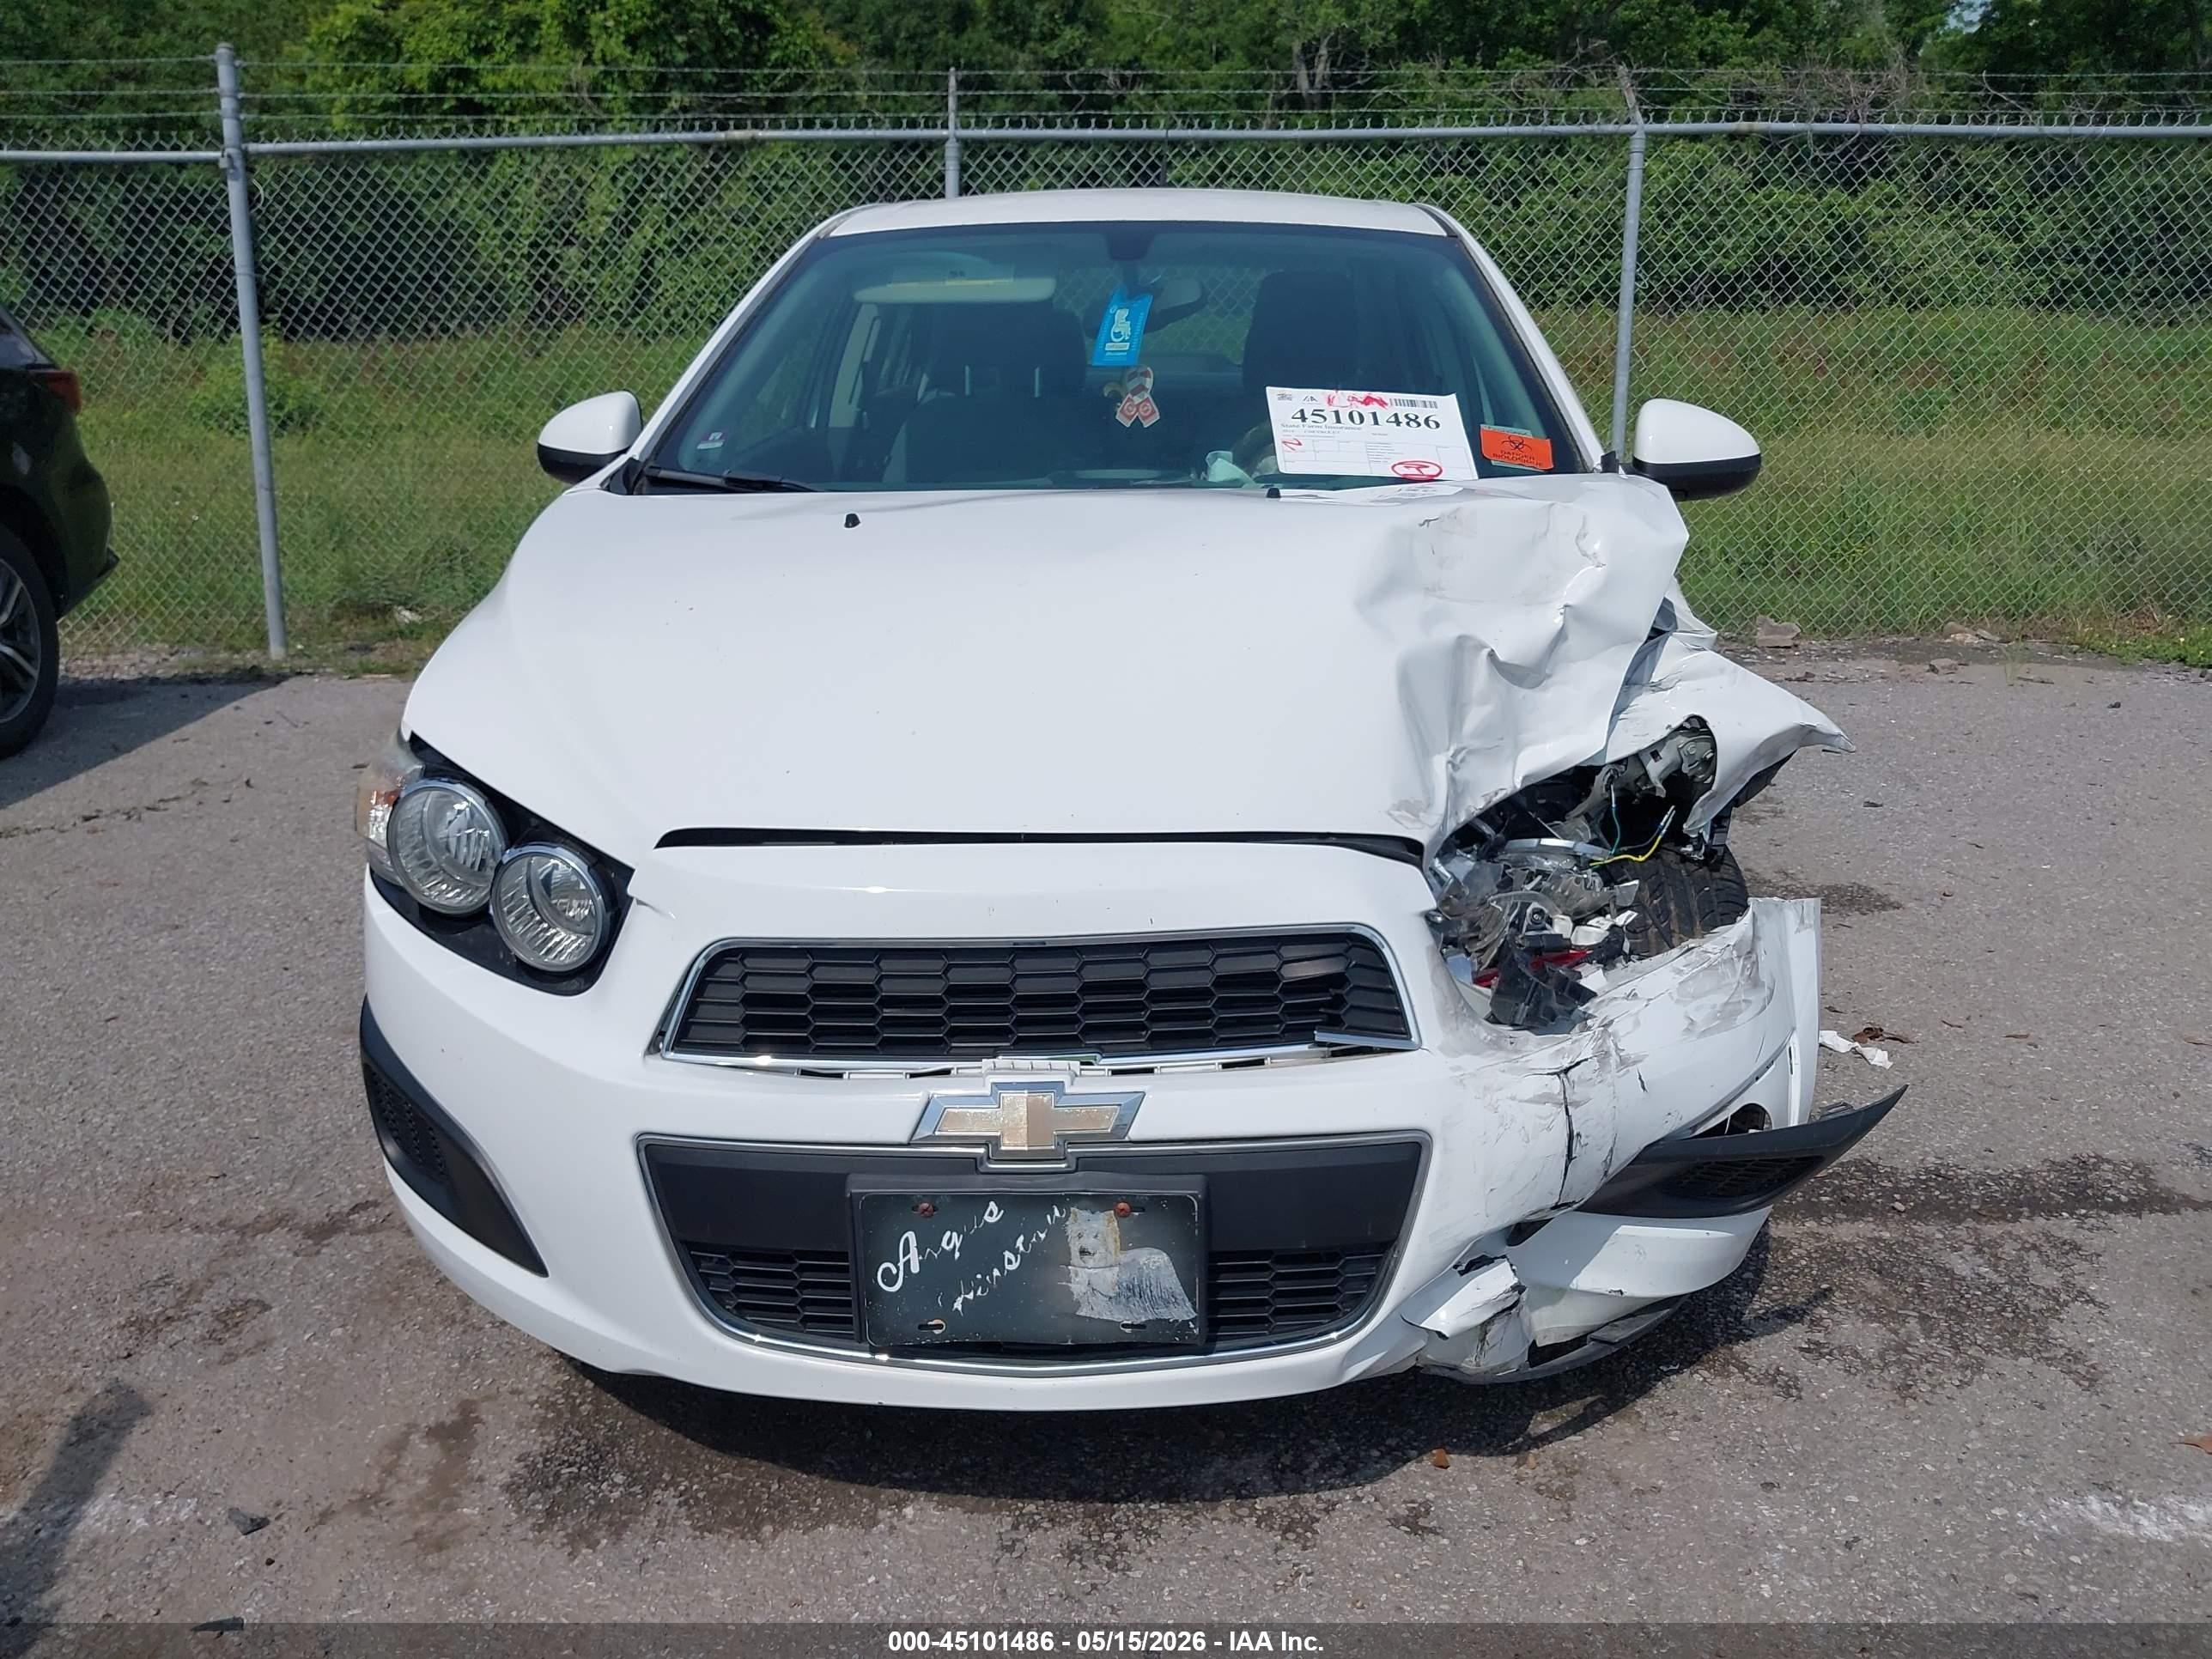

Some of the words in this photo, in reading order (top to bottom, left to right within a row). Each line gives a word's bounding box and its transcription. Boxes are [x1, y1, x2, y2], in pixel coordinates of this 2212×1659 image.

[1291, 408, 1440, 429] 45101486
[1492, 453, 1543, 467] BIOLOGIQUE
[1500, 449, 1535, 461] DANGER
